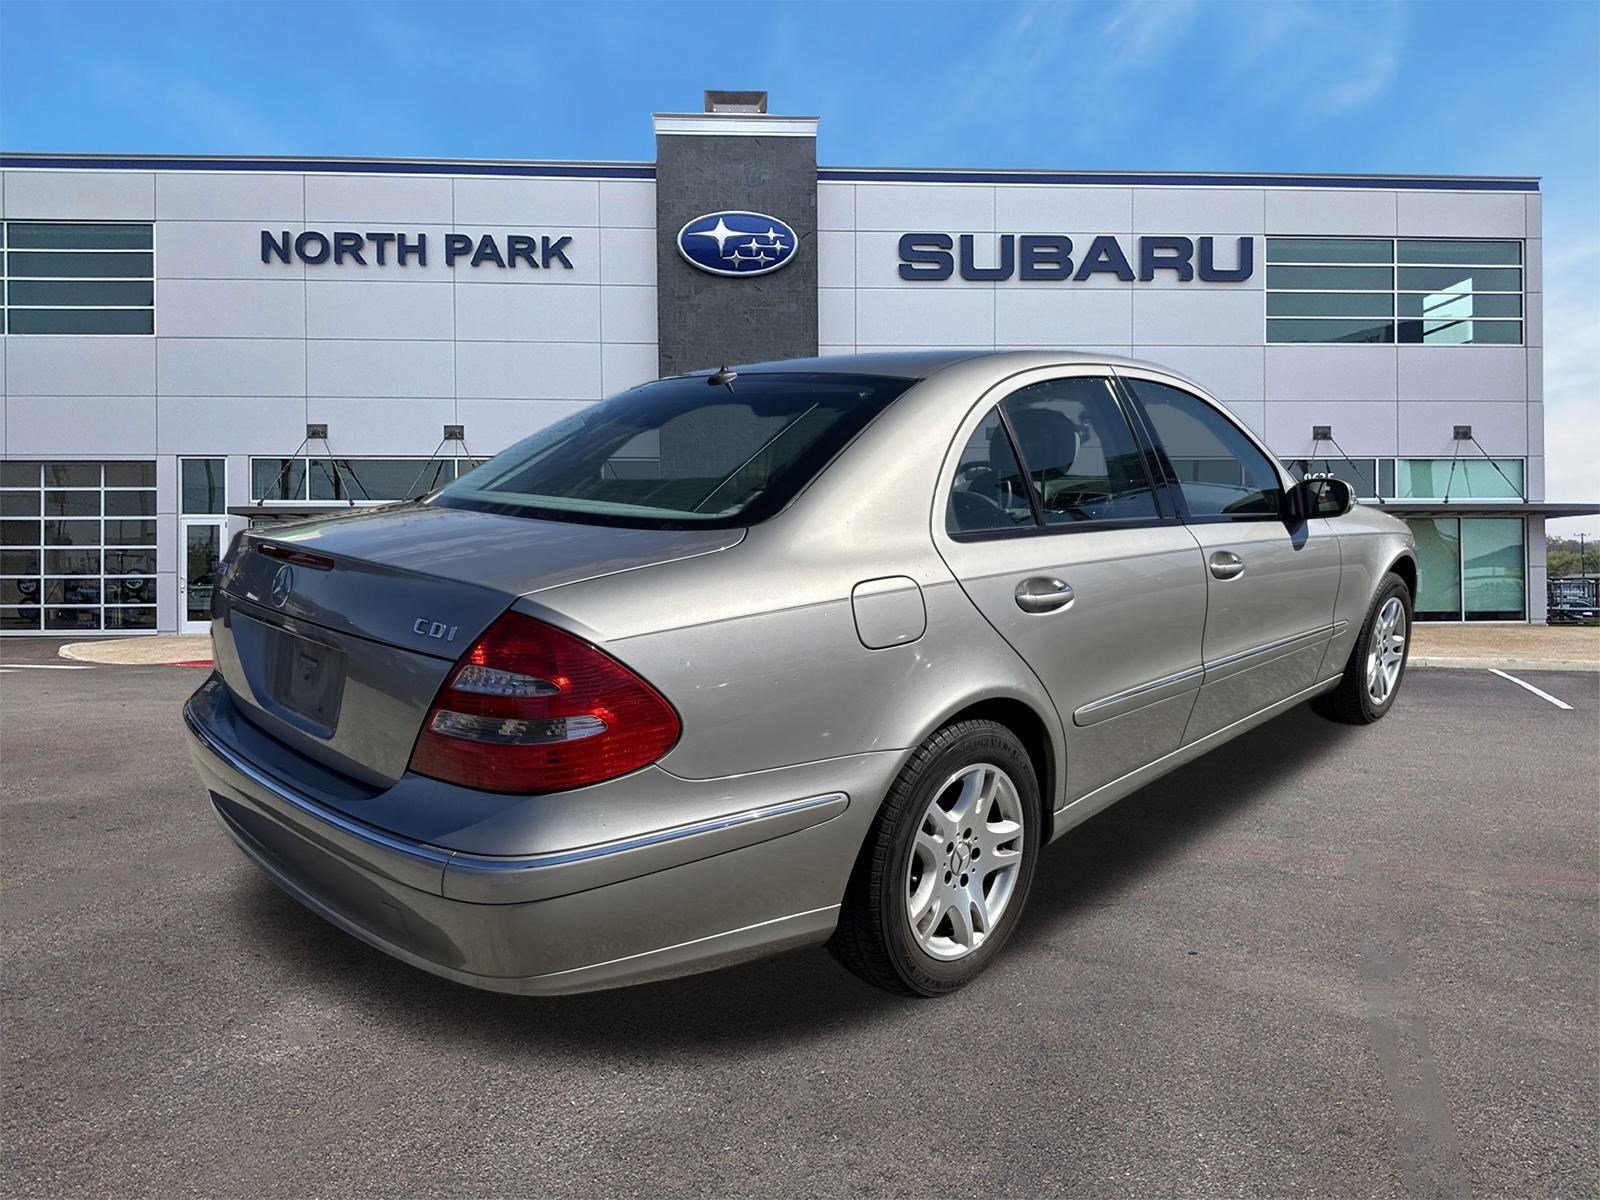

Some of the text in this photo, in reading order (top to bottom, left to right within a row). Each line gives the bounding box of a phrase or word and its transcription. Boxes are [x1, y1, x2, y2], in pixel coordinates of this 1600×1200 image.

[261, 230, 574, 269] NORTH PARK
[898, 233, 1255, 282] SUBARU
[413, 617, 458, 642] CDI
